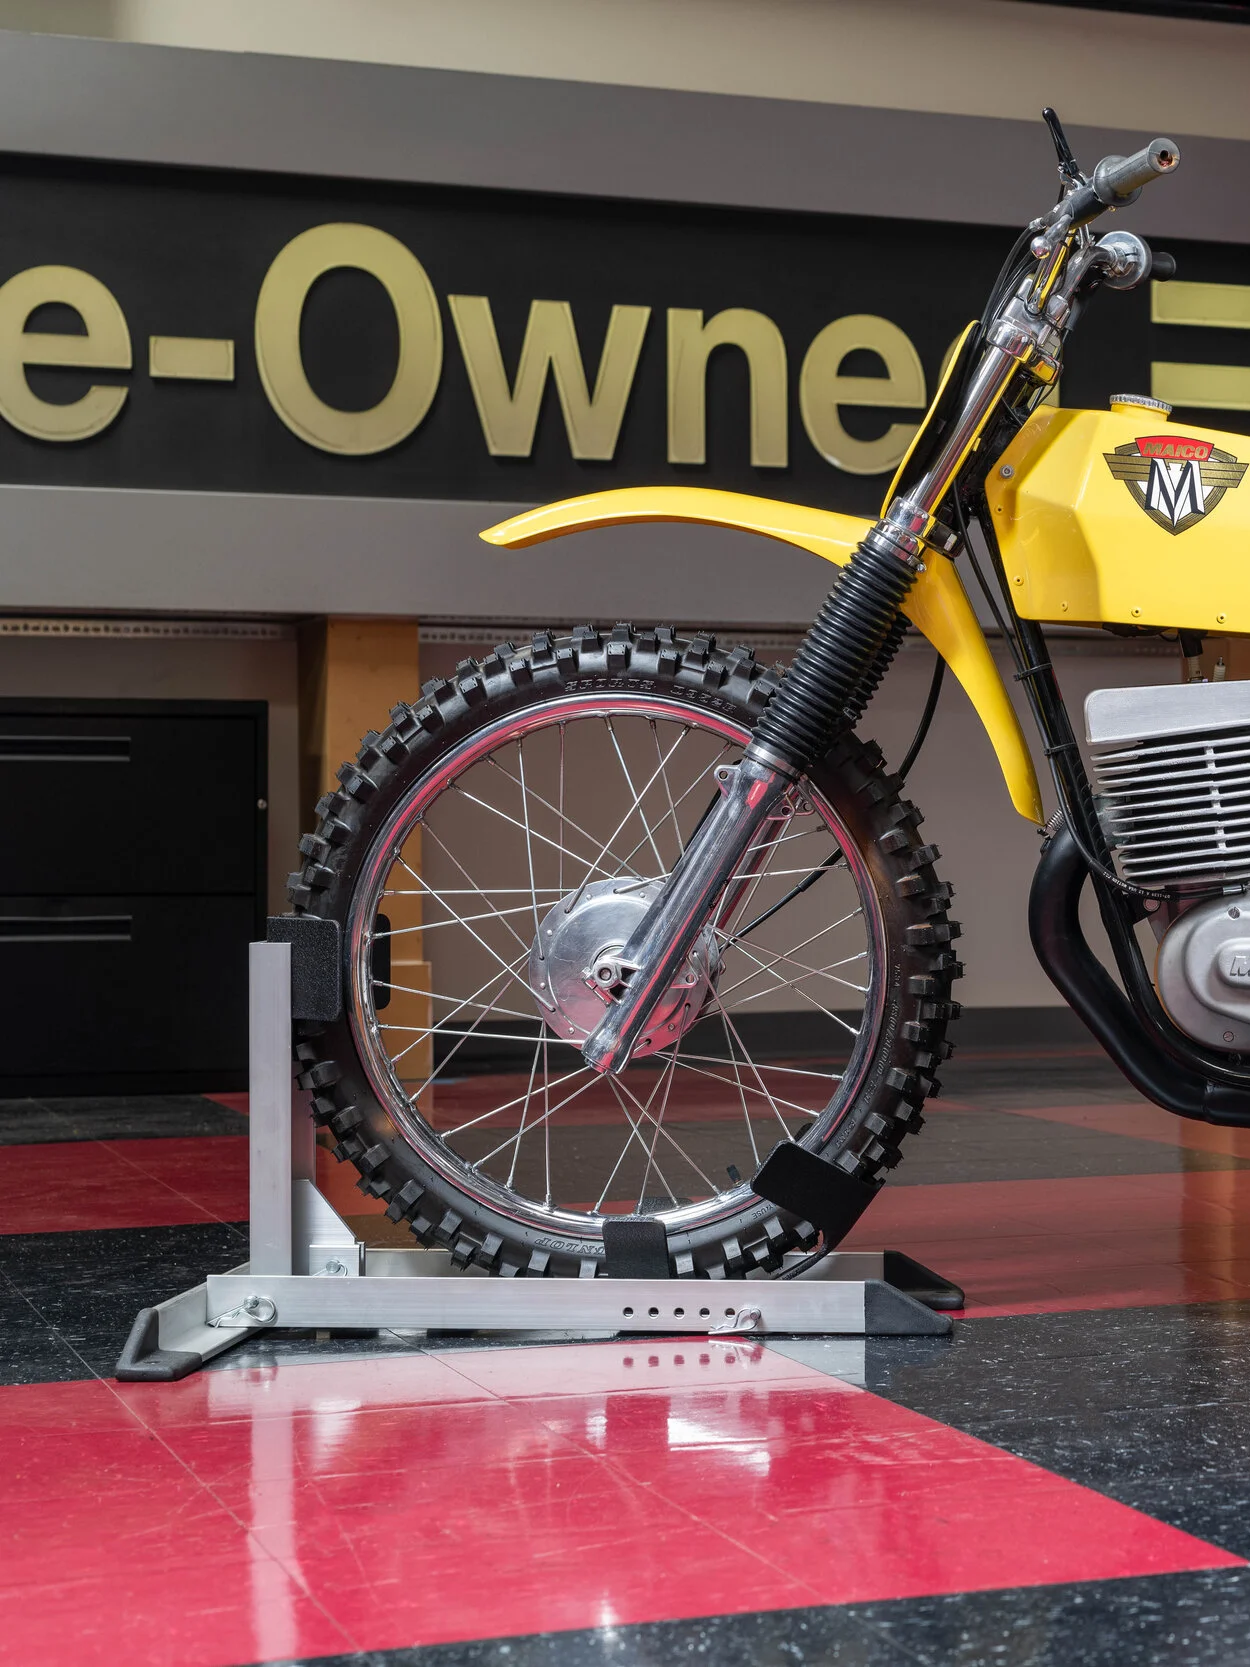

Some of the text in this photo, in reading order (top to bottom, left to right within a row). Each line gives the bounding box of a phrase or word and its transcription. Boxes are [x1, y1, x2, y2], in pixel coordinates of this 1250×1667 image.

[0, 222, 962, 475] e-Owne
[1143, 441, 1209, 460] MAICO
[534, 1237, 605, 1256] UNLOP
